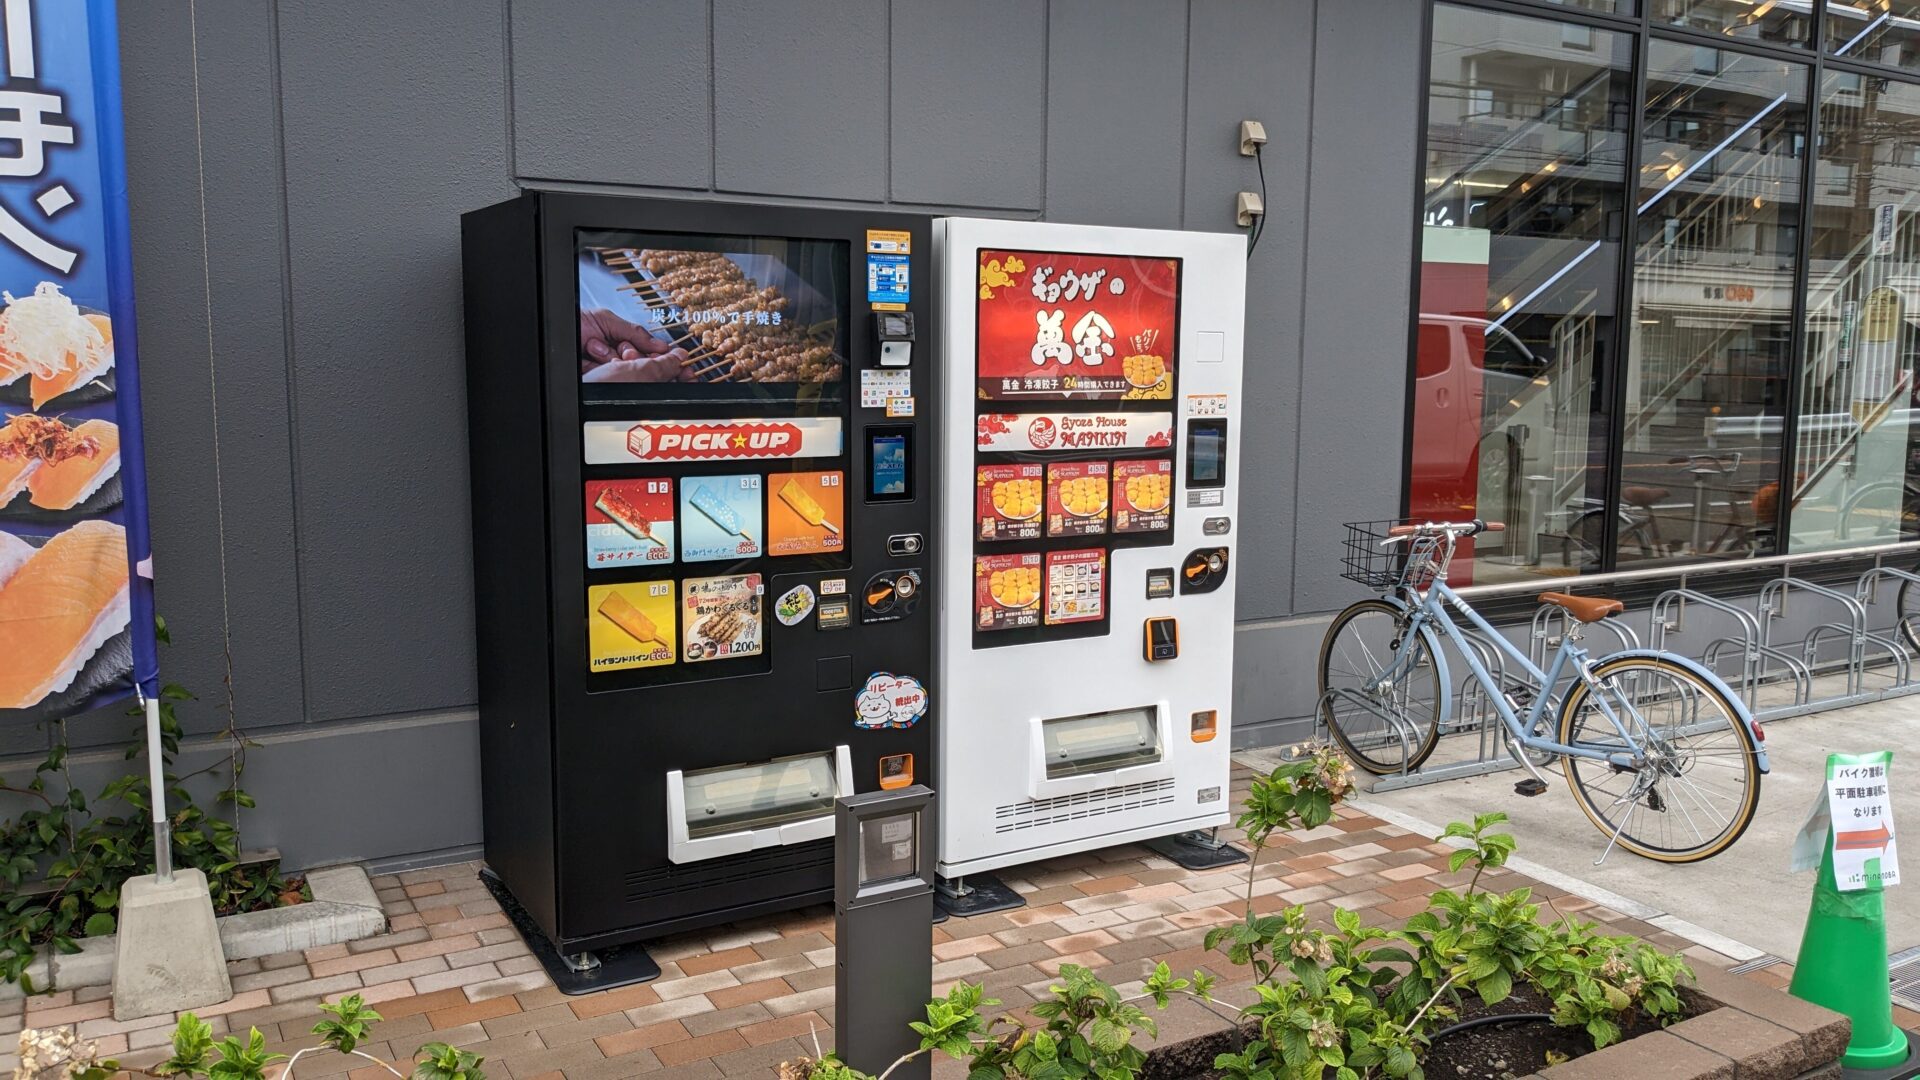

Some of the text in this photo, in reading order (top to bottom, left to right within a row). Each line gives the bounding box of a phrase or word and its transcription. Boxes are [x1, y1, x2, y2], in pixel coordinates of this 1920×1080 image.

[1031, 265, 1126, 304] ギョウザの
[651, 308, 783, 326] 炭火100%で手焼き
[1031, 308, 1116, 367] 萬金
[1060, 416, 1128, 430] Gyoza House
[657, 431, 791, 452] PICK UP
[1060, 431, 1127, 448] MANKIN
[870, 680, 912, 694] リピーター
[1853, 805, 1883, 818] なります
